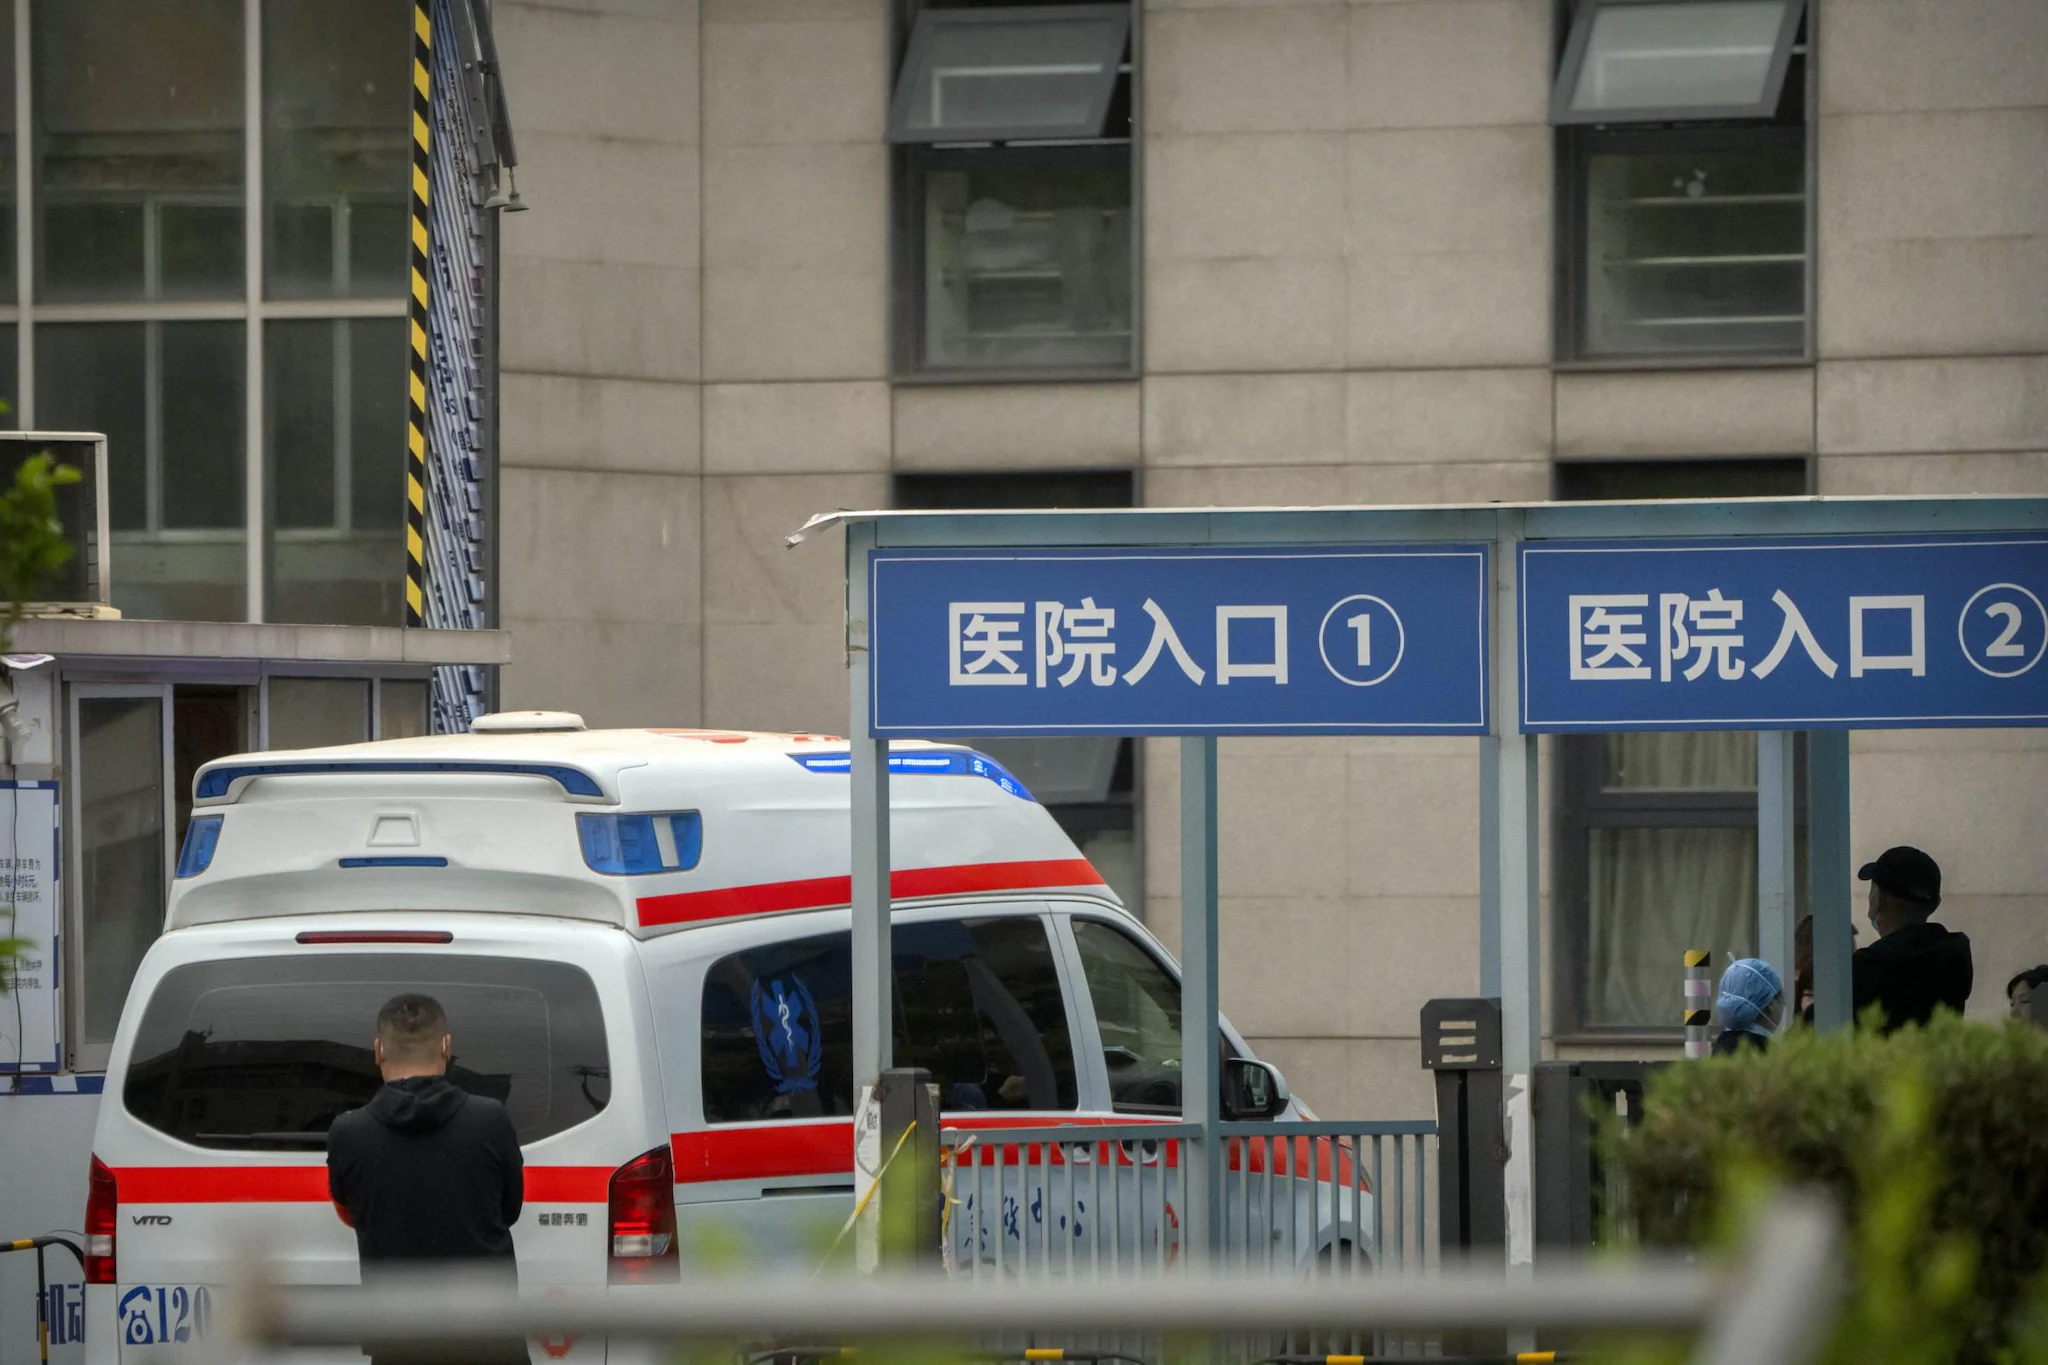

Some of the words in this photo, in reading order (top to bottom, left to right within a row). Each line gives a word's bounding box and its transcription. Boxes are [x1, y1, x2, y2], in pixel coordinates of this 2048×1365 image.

[948, 596, 1289, 688] 医院入口
[1568, 588, 1926, 682] 医院入口
[132, 1215, 172, 1226] VITO
[155, 1286, 212, 1344] 120
